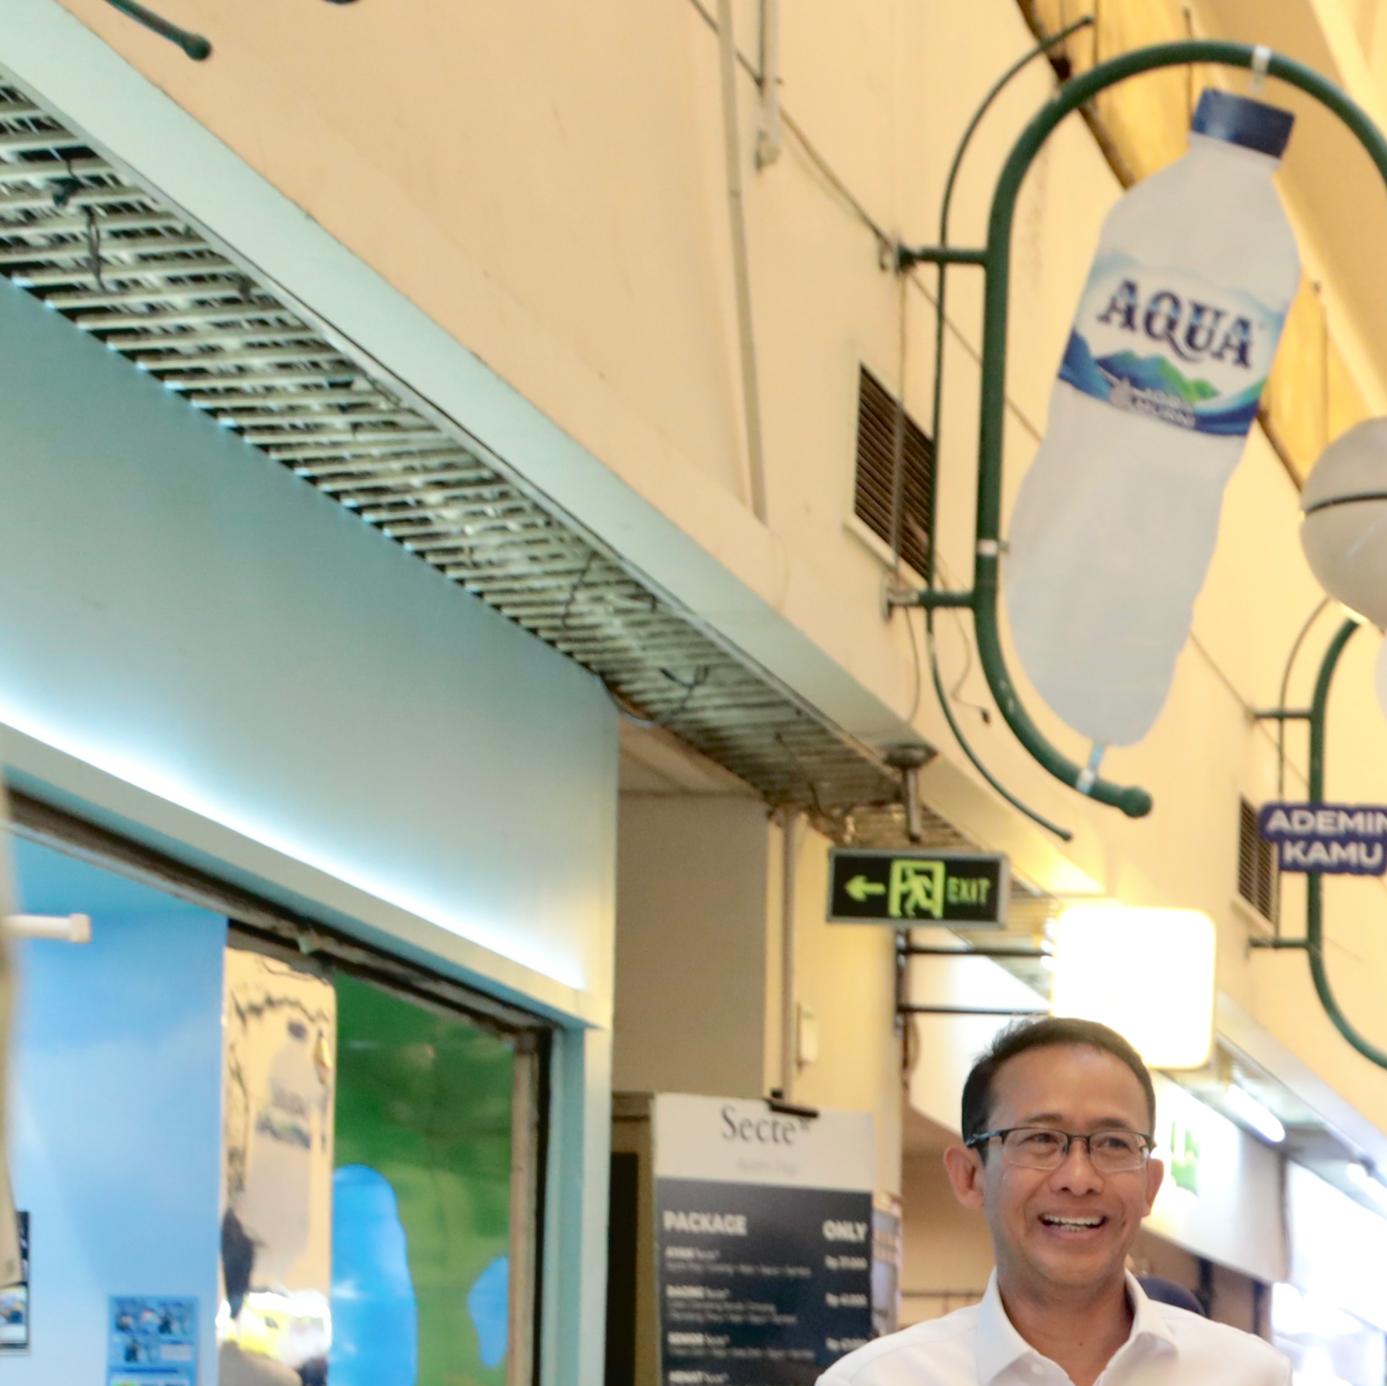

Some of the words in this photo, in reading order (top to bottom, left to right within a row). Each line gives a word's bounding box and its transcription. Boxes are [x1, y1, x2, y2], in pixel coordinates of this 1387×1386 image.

[1097, 279, 1252, 369] AQUA
[1282, 841, 1383, 867] KAMU
[947, 876, 991, 905] EXIT
[662, 1210, 748, 1237] PACKAGE
[821, 1219, 868, 1243] ONLY
